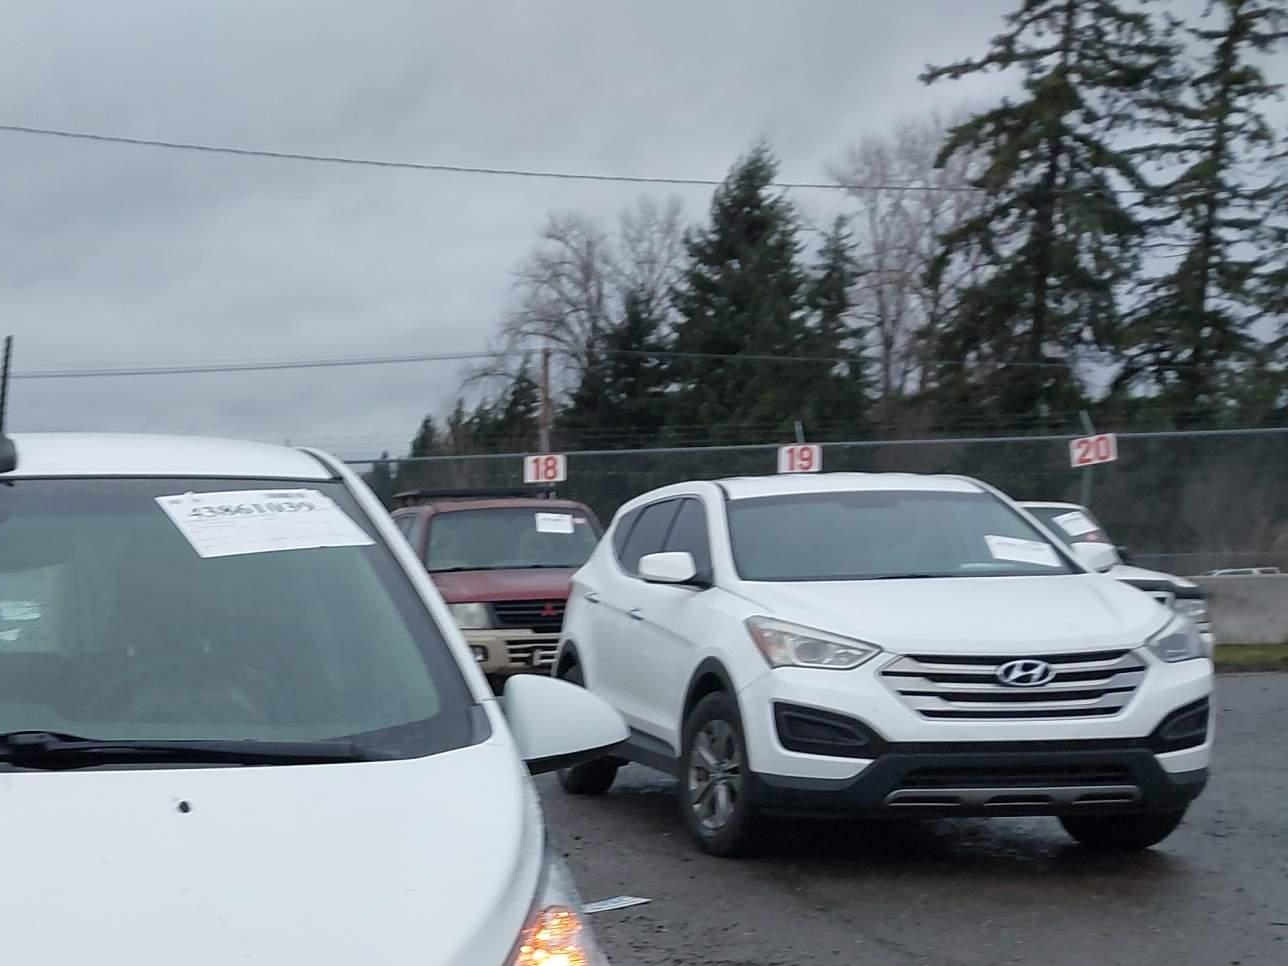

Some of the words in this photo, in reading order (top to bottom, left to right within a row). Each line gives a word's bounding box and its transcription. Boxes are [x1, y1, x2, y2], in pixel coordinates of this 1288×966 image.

[787, 446, 813, 471] 19
[1078, 436, 1112, 464] 20
[532, 456, 558, 480] 18
